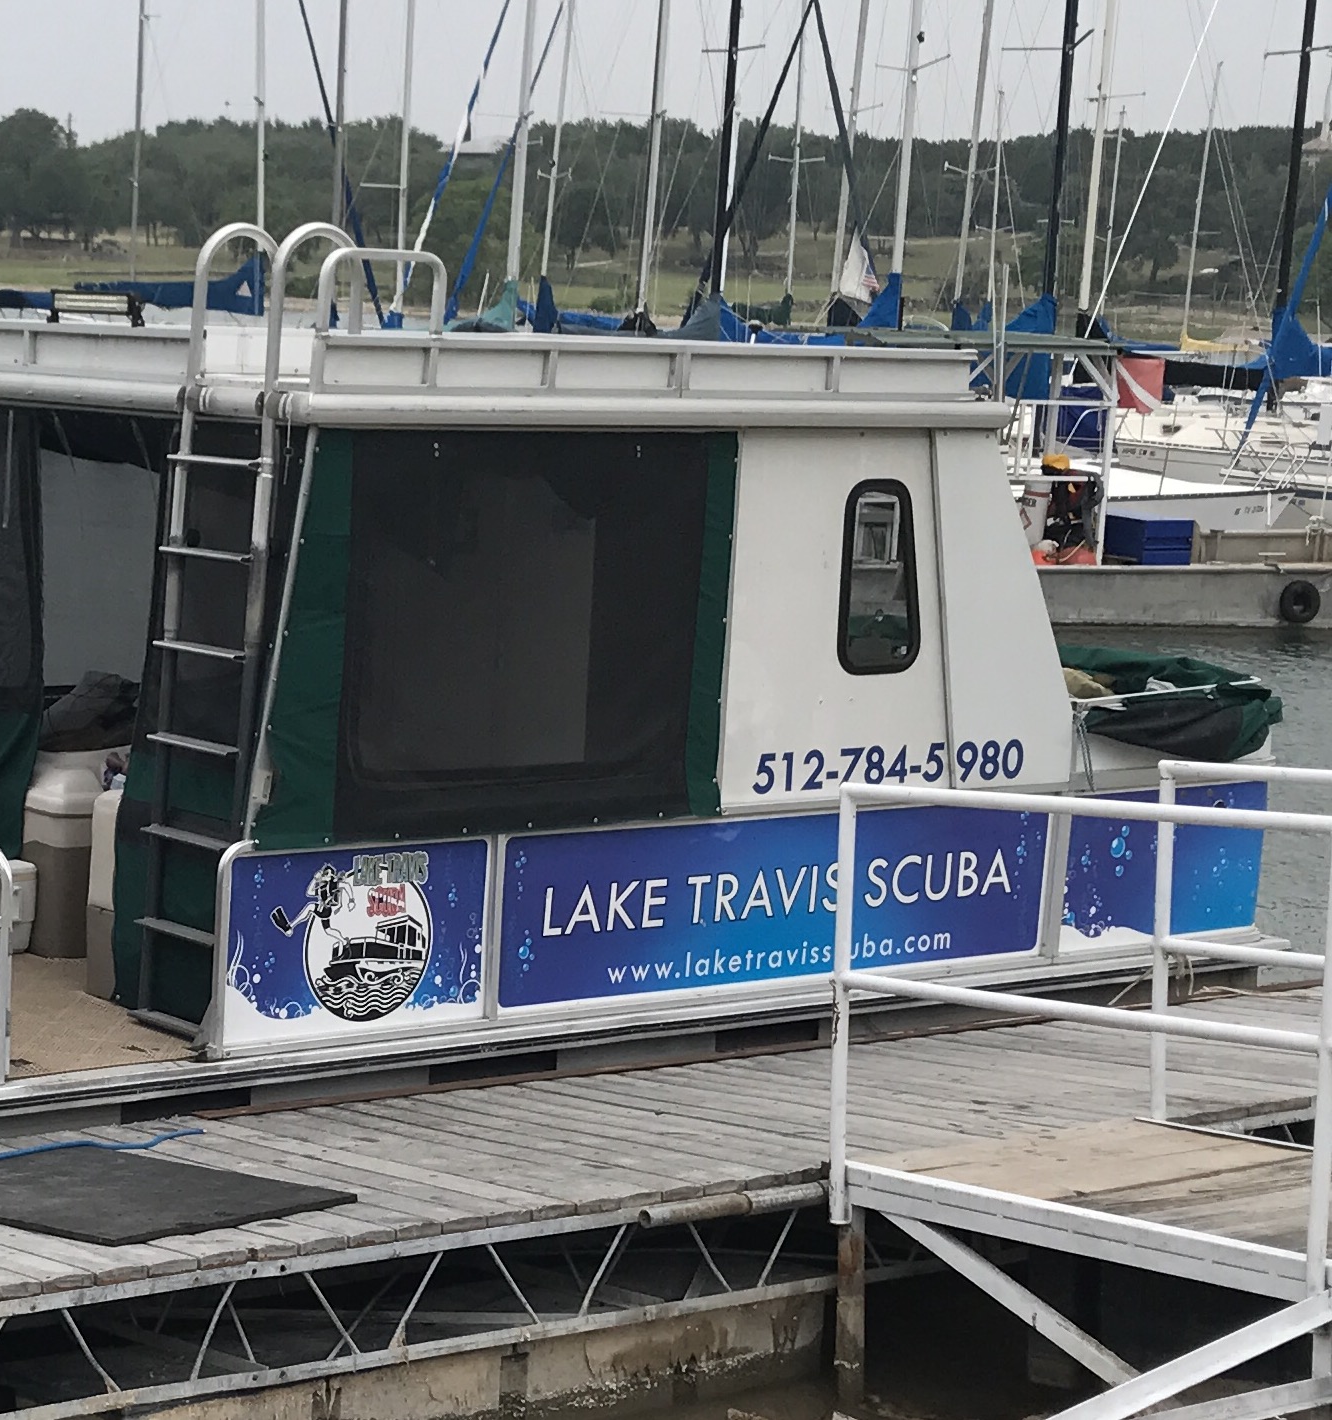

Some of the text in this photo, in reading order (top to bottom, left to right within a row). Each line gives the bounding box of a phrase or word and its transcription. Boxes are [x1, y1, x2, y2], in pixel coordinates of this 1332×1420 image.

[542, 848, 1012, 937] LAKE TRAVIS SCUBA
[607, 931, 951, 985] www.laketravissuba.com
